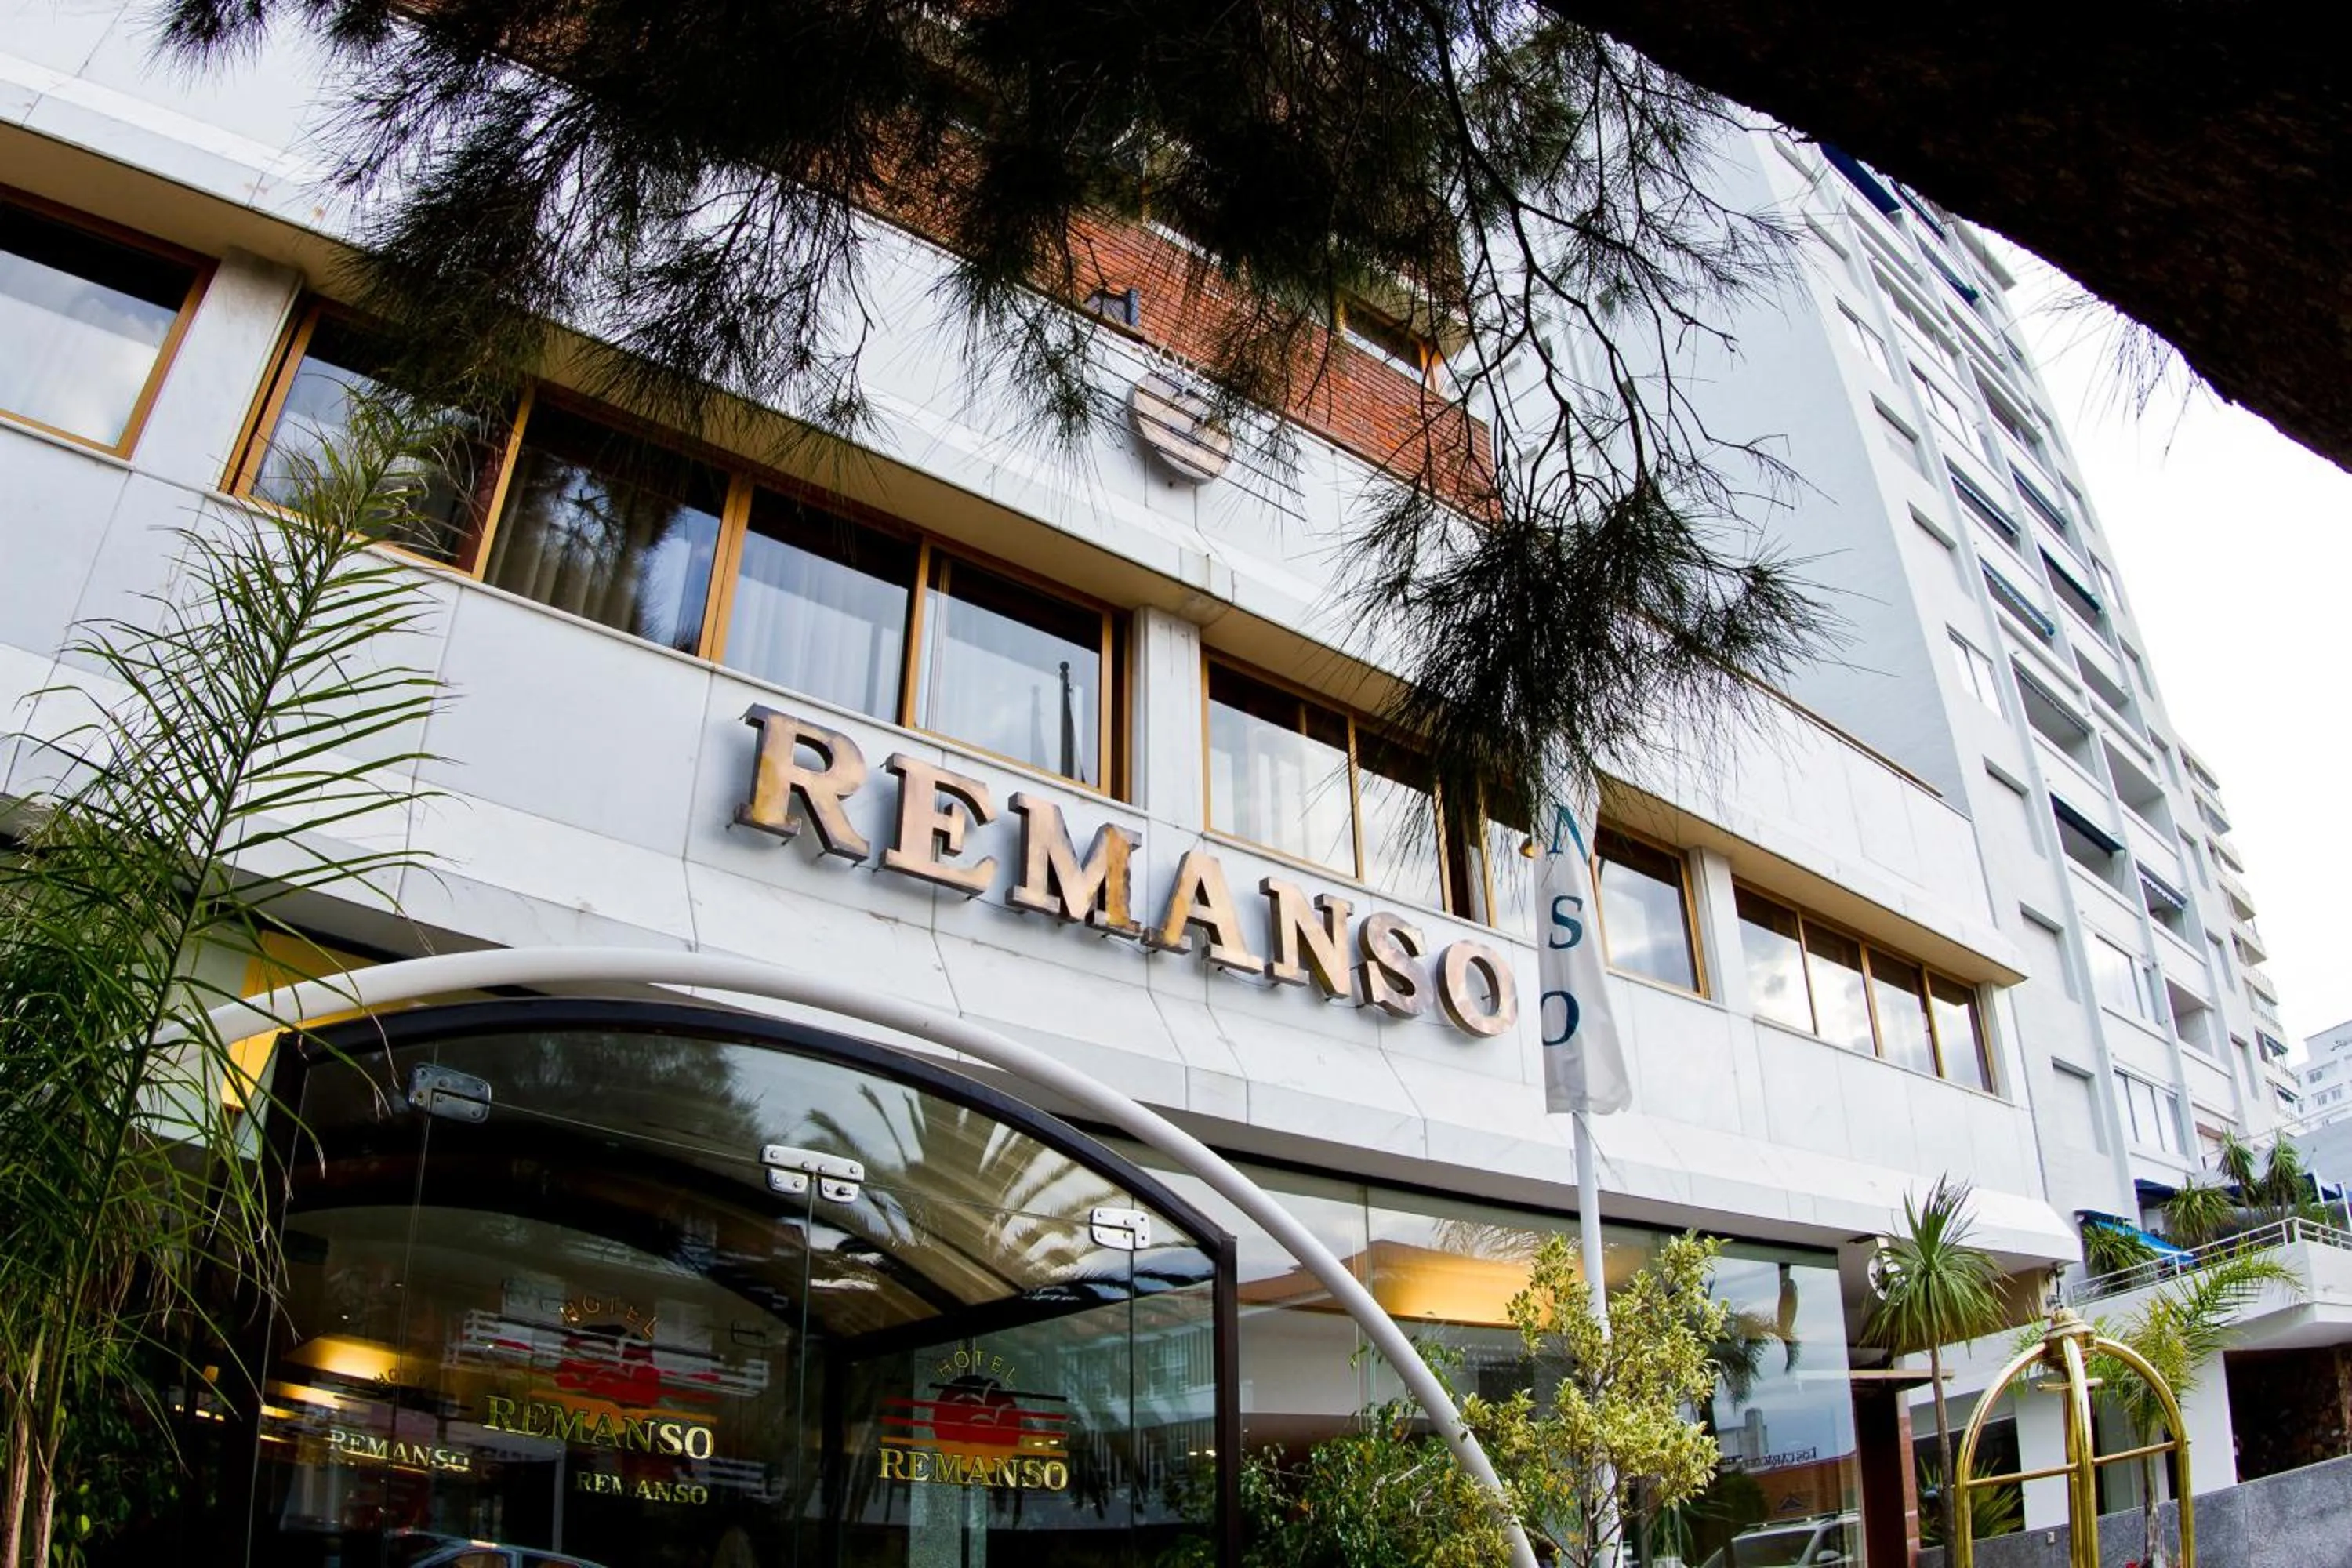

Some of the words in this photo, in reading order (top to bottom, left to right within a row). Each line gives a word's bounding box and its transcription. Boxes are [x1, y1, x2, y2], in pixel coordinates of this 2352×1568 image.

[734, 703, 1518, 1036] REMANSO
[329, 1428, 470, 1472] REMANSO
[482, 1395, 714, 1460] REMANSO
[877, 1446, 1069, 1491] REMANSO
